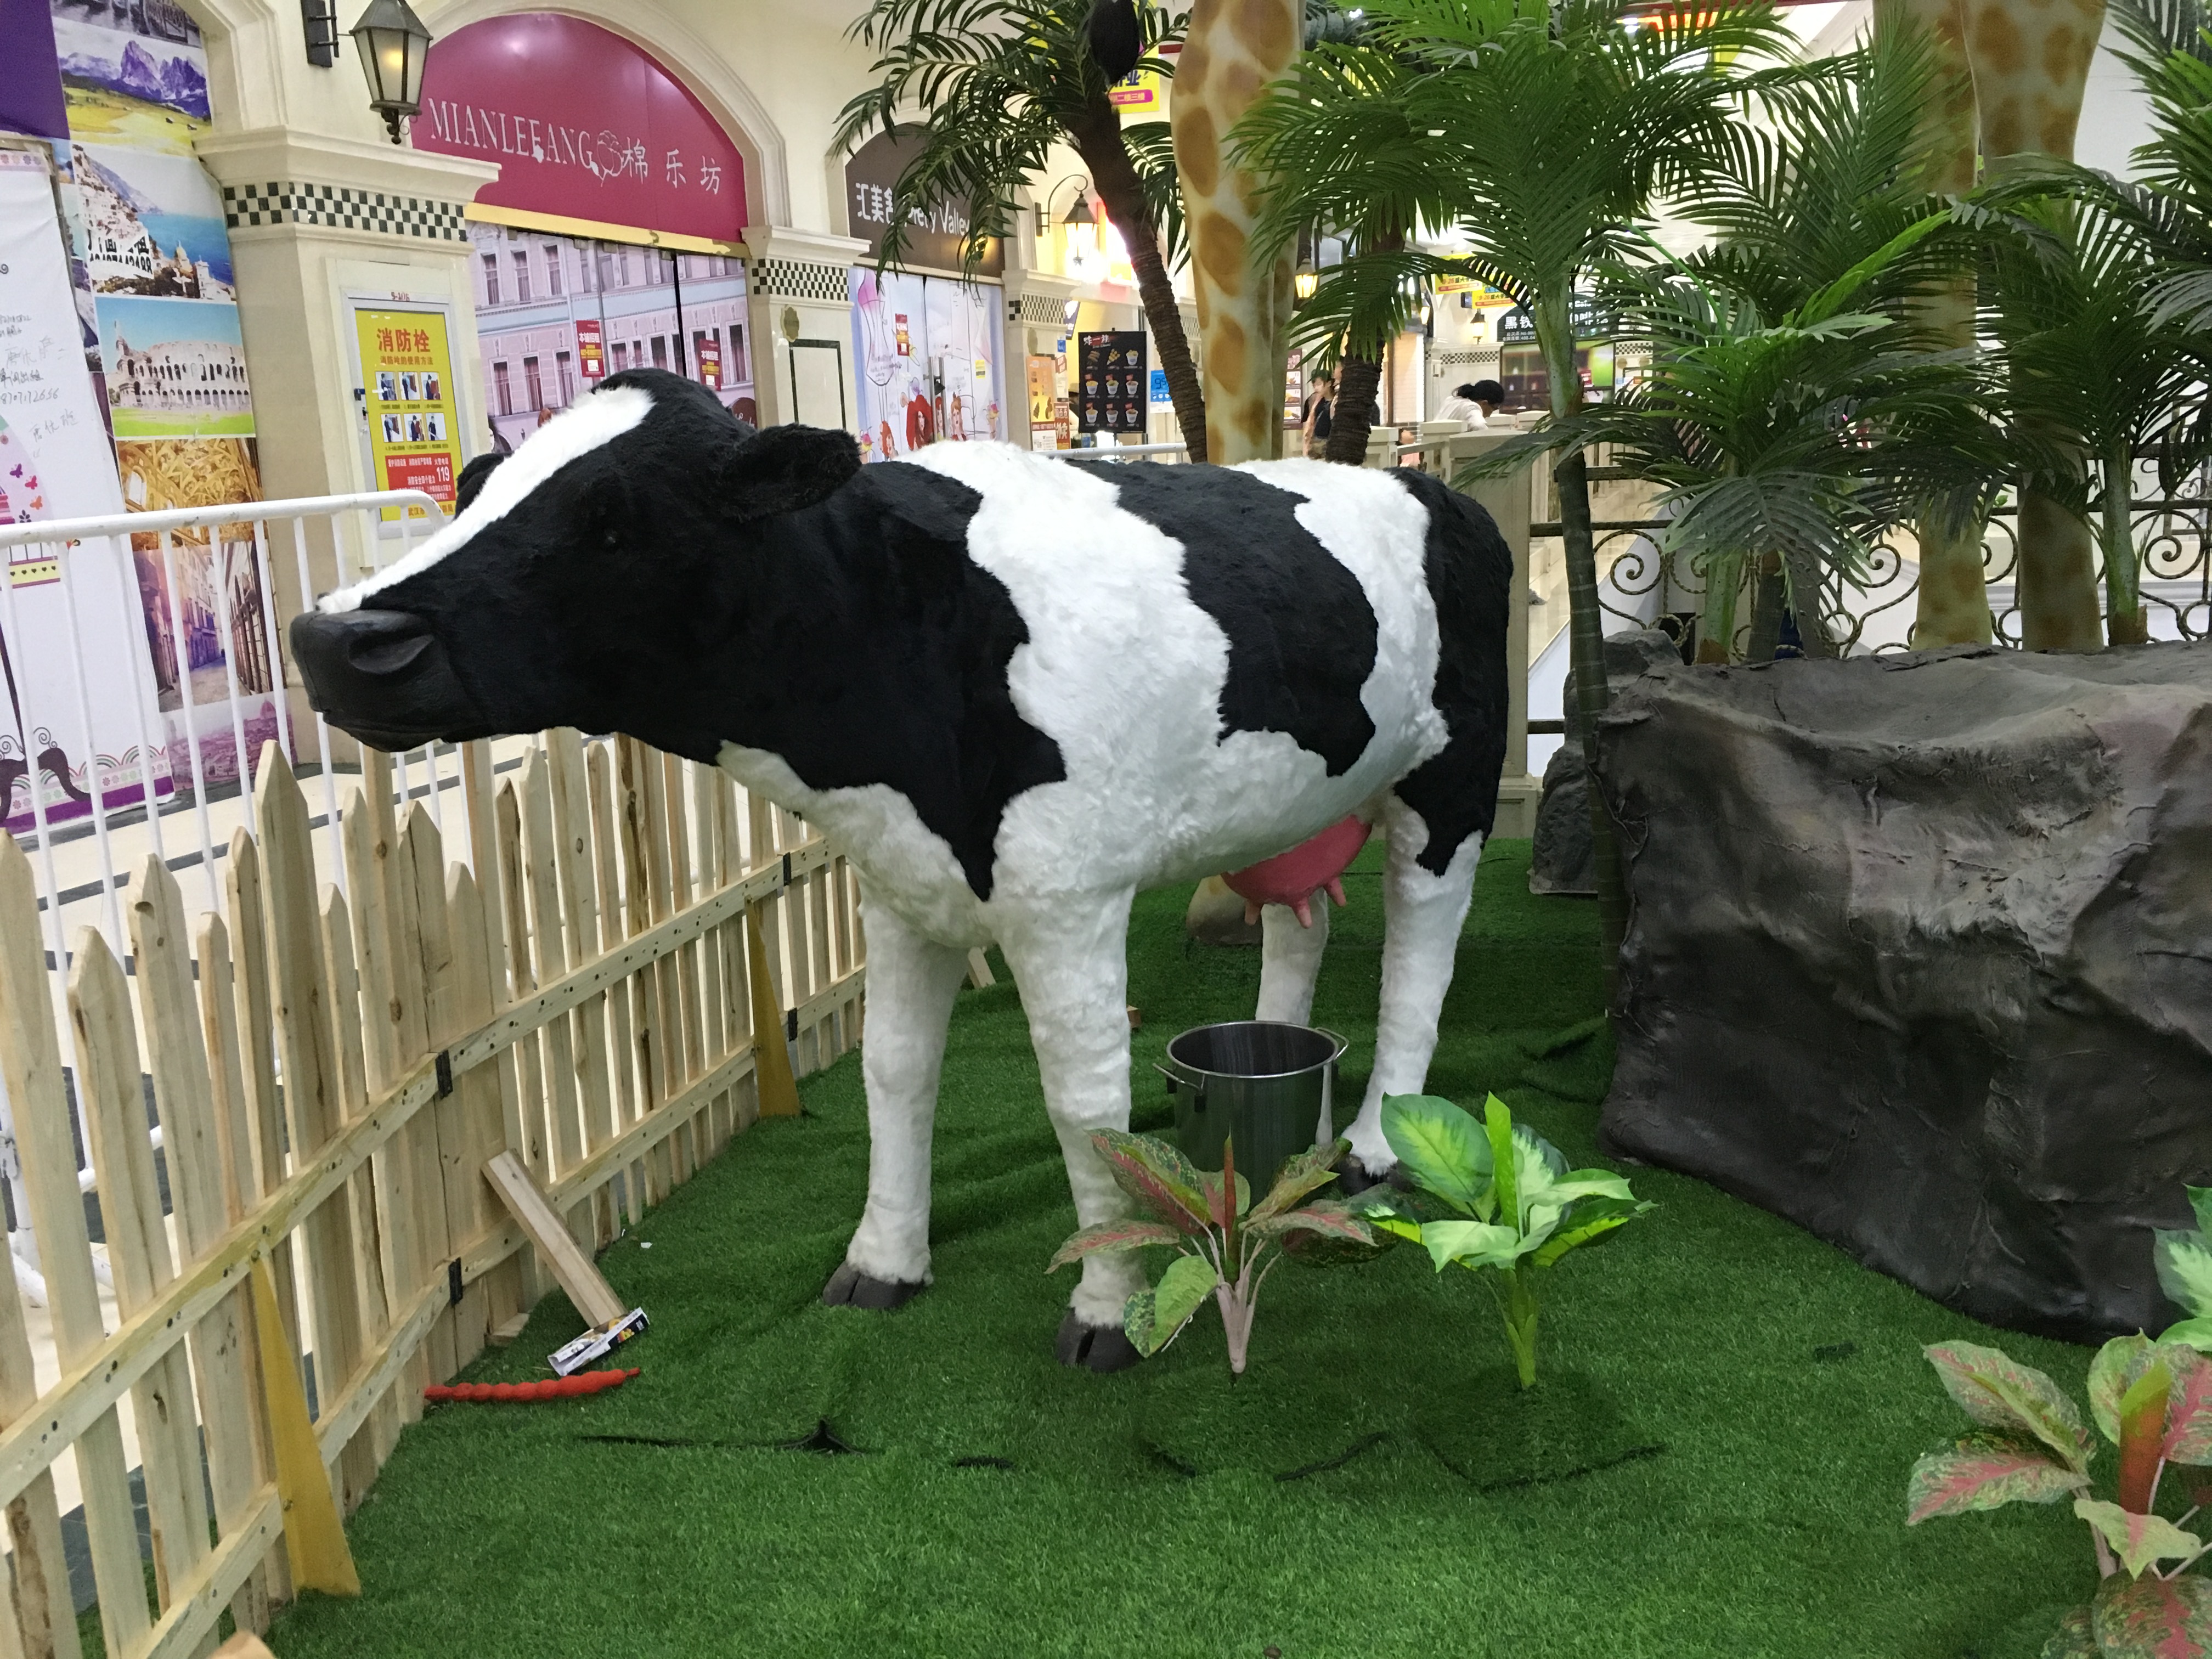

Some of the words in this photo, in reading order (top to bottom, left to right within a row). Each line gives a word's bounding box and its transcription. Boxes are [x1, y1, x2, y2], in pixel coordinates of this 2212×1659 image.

[427, 98, 593, 169] MIANLEFANG
[622, 137, 721, 195] 棉乐坊
[377, 328, 431, 353] 消防栓
[436, 466, 450, 482] 119
